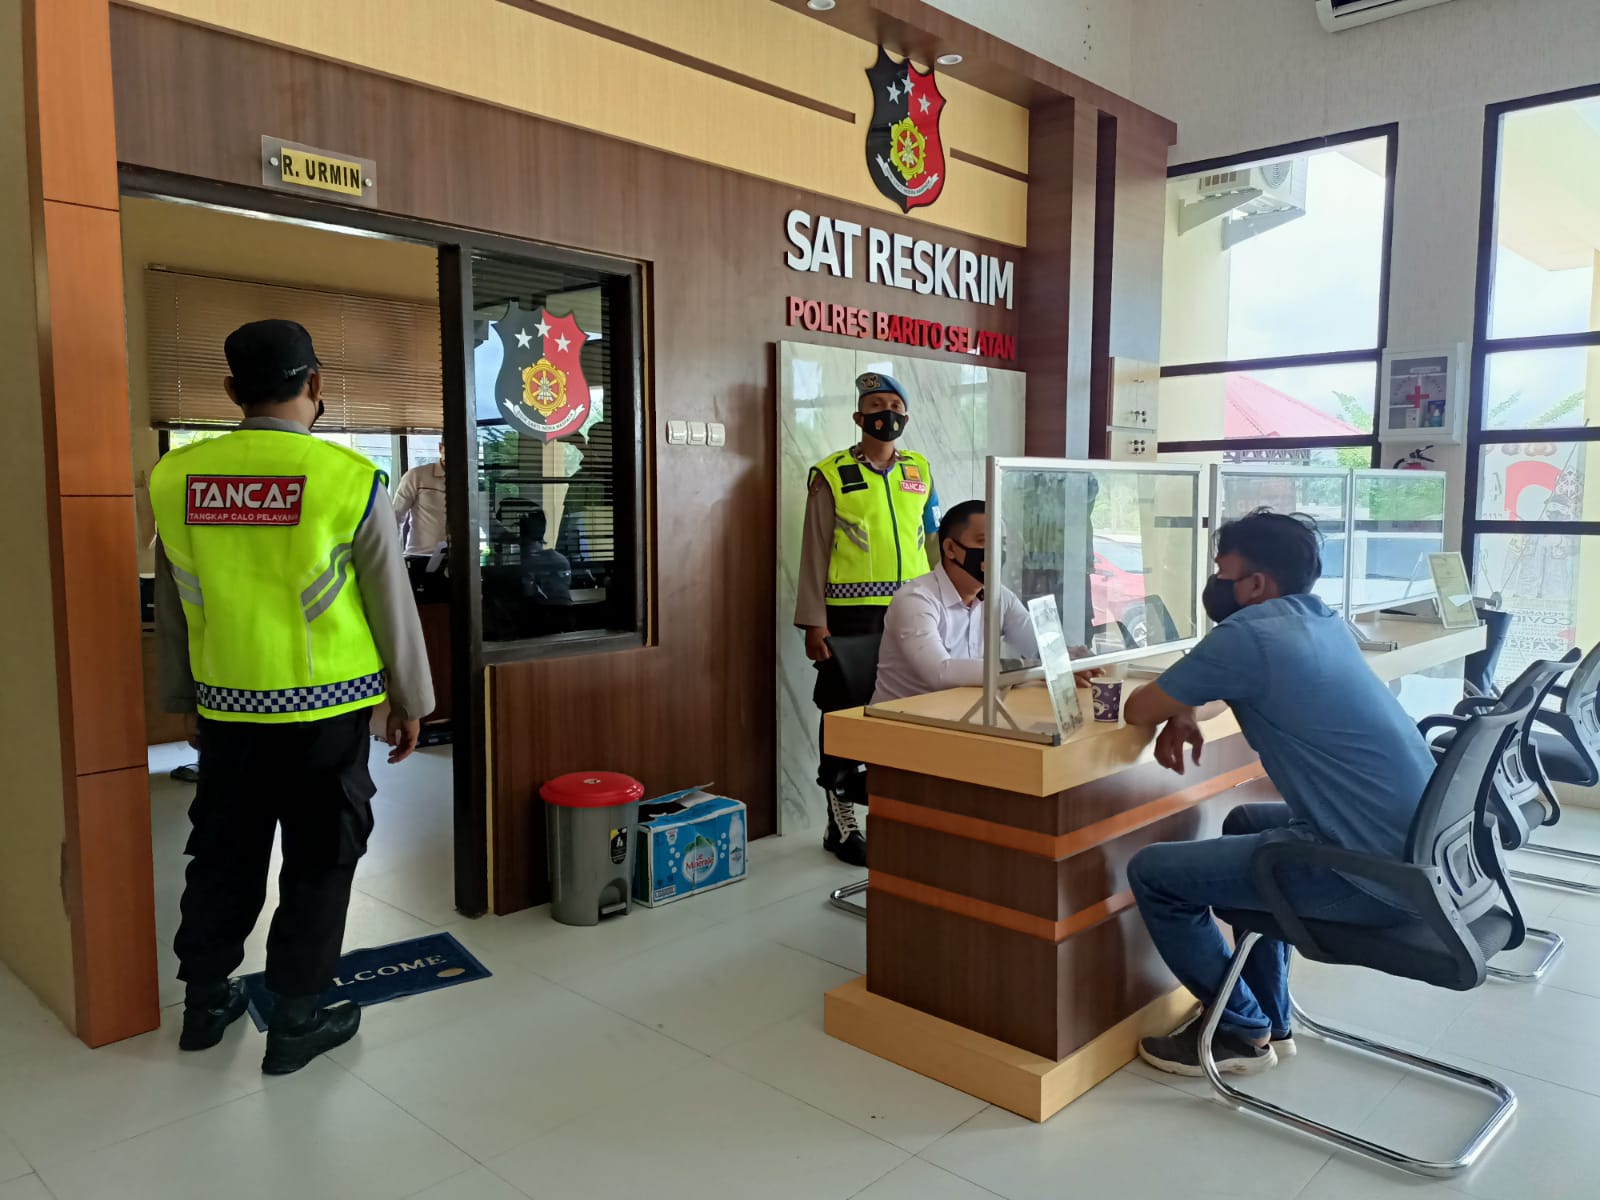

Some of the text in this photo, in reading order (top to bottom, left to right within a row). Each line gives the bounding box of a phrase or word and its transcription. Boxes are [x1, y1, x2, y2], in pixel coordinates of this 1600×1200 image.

[282, 154, 360, 189] R. URMIN
[786, 209, 1014, 310] SAT RESKRIM
[788, 296, 1016, 361] POLRES BARITO SELATAN
[191, 482, 301, 509] TANCAP
[189, 512, 229, 521] TANGKAP
[231, 513, 254, 521] CALO
[332, 954, 447, 987] LCOME
